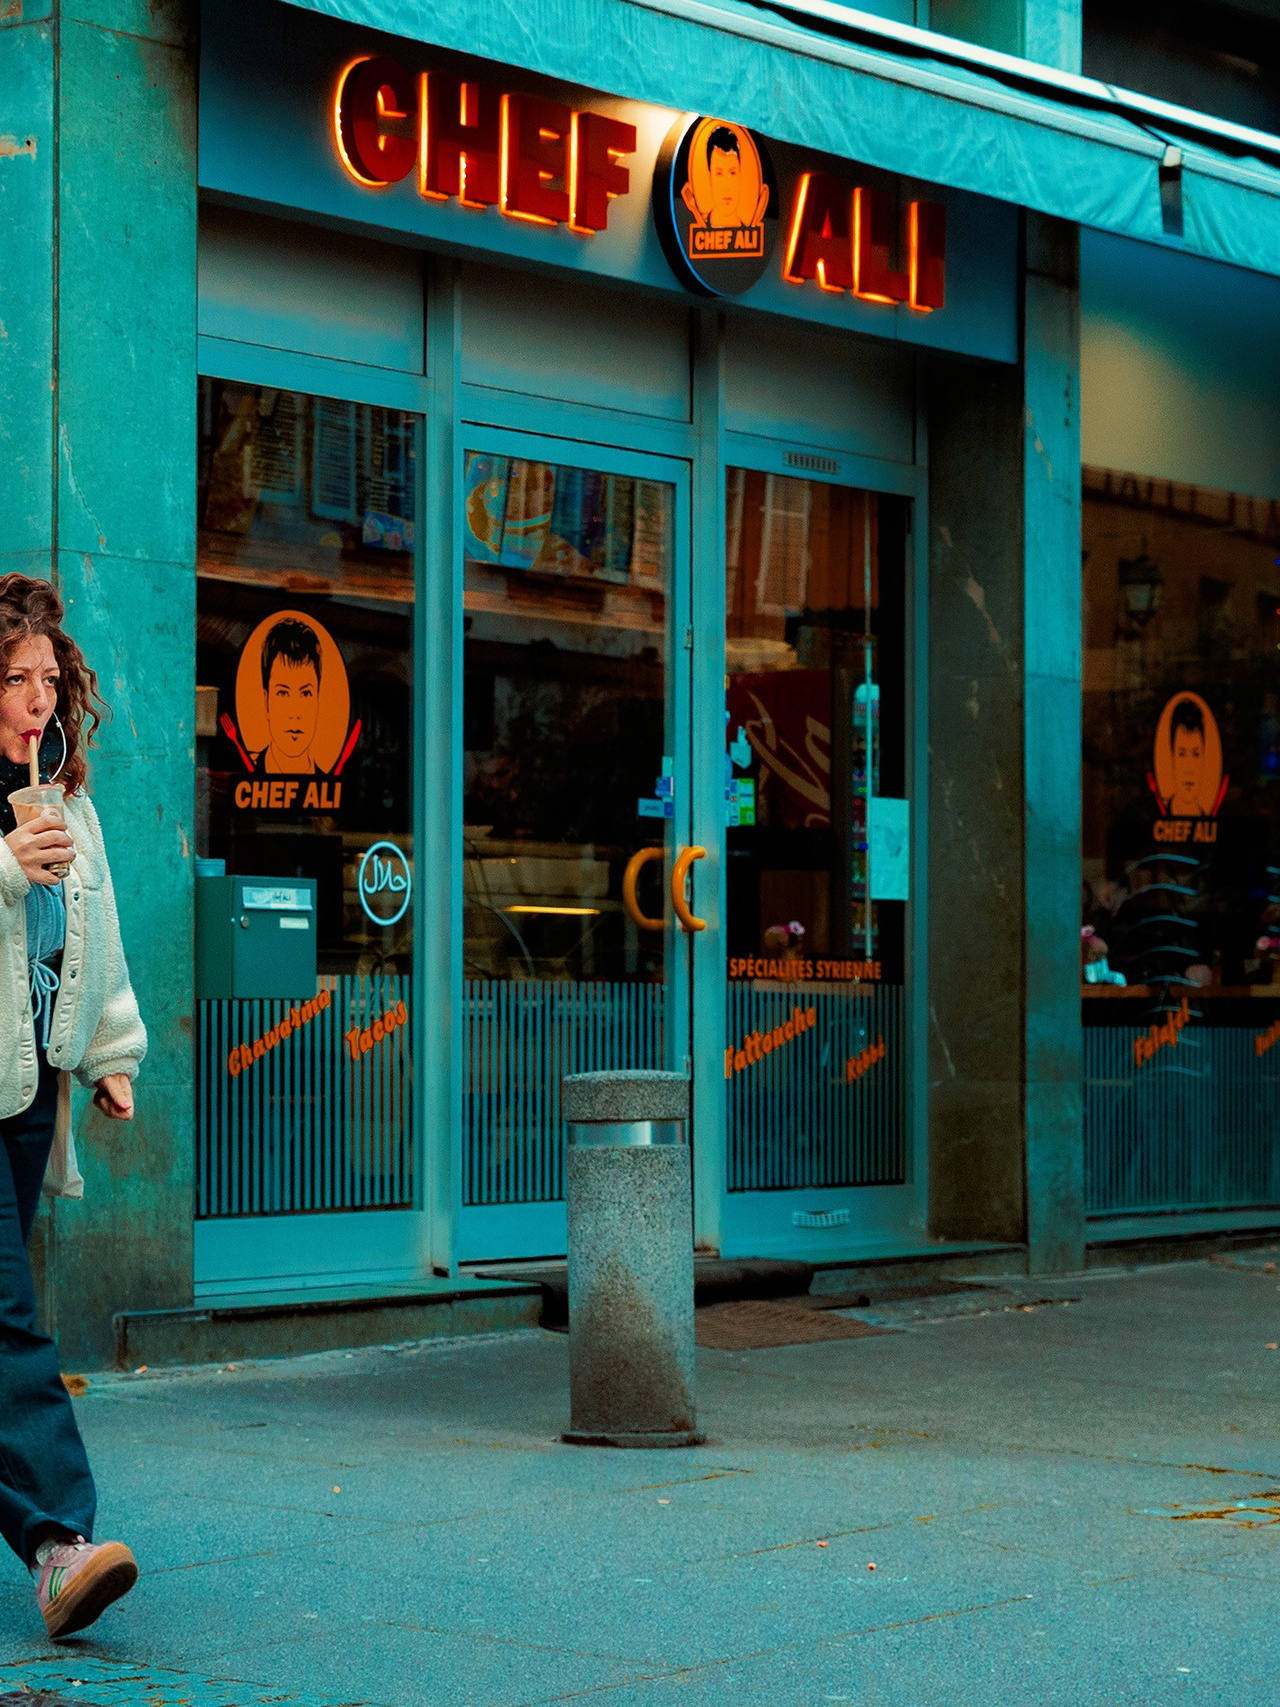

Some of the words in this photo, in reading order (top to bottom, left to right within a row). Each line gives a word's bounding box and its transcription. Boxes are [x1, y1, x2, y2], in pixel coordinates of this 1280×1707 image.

[334, 56, 638, 234] CHEF
[783, 173, 945, 312] ALI
[694, 231, 732, 250] CHEF
[734, 230, 757, 249] ALI
[235, 781, 299, 809] CHEF
[303, 782, 341, 808] ALI
[1153, 819, 1192, 843] CHEF
[1193, 820, 1218, 843] ALI
[364, 854, 407, 893] حلال
[816, 960, 882, 979] SYRIENNE
[227, 989, 331, 1077] Chawarma
[346, 1001, 407, 1060] Tacos
